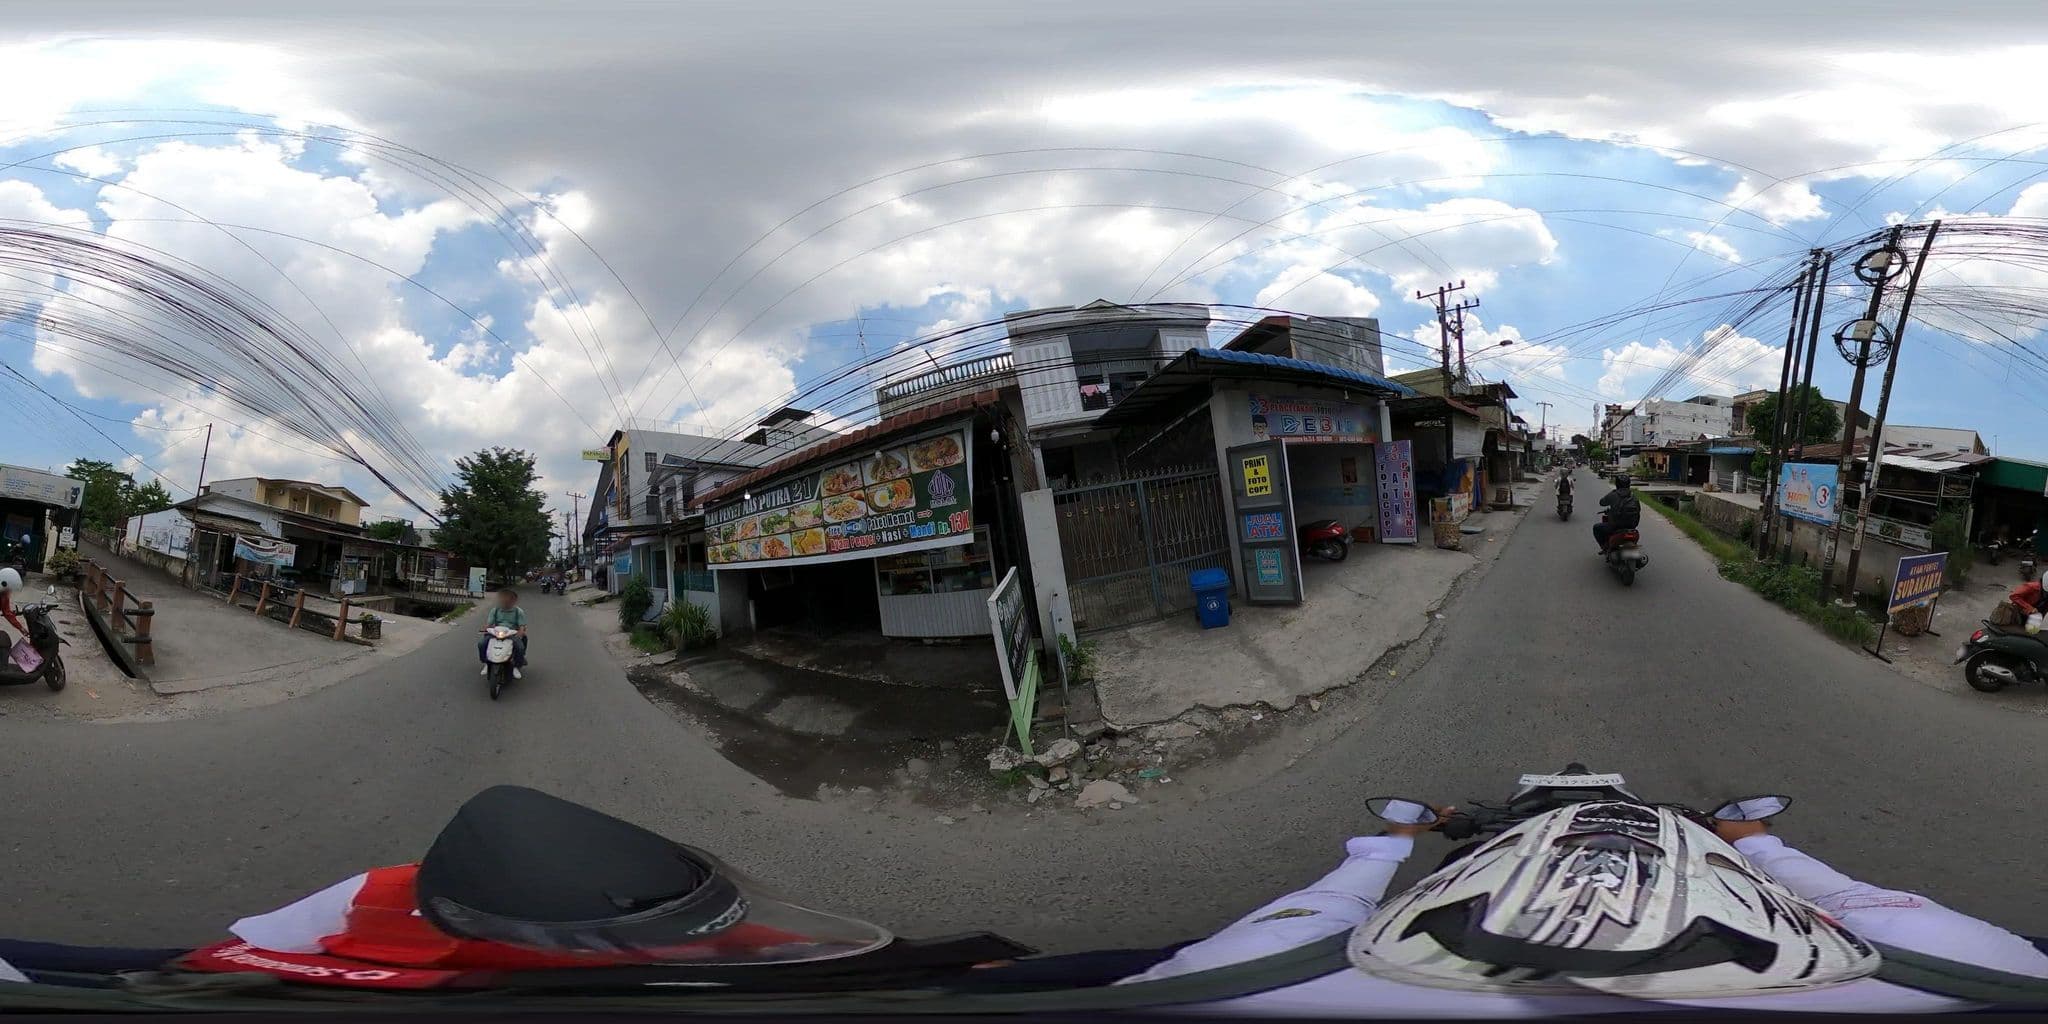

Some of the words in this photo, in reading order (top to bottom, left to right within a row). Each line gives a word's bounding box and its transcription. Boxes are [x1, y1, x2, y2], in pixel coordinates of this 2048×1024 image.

[1244, 457, 1266, 469] PRINT
[1253, 468, 1259, 476] &
[1248, 476, 1267, 485] FOTO
[743, 496, 758, 515] MAS
[759, 486, 791, 510] PUTRA
[792, 476, 813, 501] 21
[1248, 484, 1269, 495] COPY
[1392, 472, 1401, 515] ATK
[1380, 463, 1392, 536] FOTOCOPY
[1401, 461, 1416, 536] PRINTING
[888, 510, 915, 527] Hemat
[1248, 513, 1281, 525] JUAL
[882, 528, 902, 543] Nasi
[949, 510, 970, 533] 13K
[1250, 526, 1280, 538] ATK
[1895, 571, 1943, 600] SURAKARTA
[1575, 816, 1659, 828] HONDA
